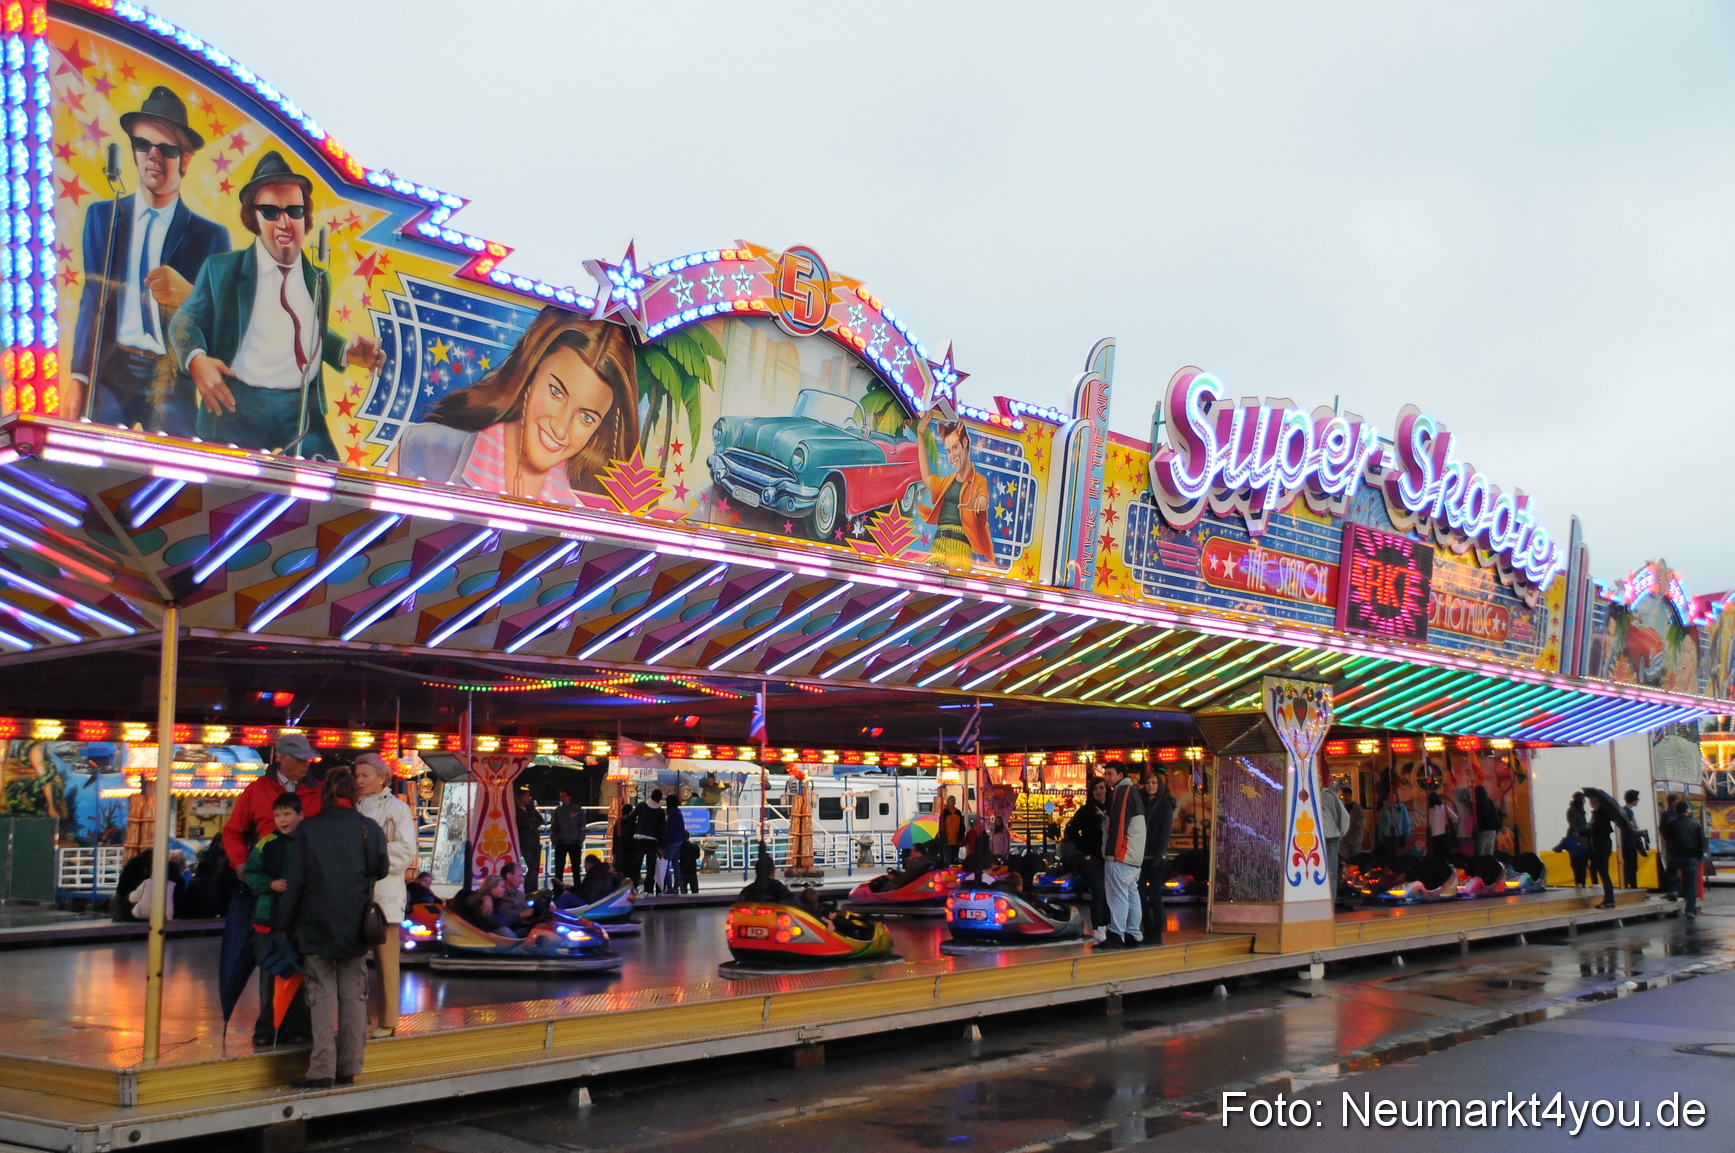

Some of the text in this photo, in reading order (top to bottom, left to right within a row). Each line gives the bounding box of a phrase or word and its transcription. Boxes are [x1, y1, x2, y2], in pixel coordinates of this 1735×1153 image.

[1081, 382, 1110, 577] MUSIC IN THE AIR
[1165, 368, 1564, 593] Super-Skooter
[1246, 548, 1329, 603] THE STATION
[1467, 602, 1493, 637] MUSIC
